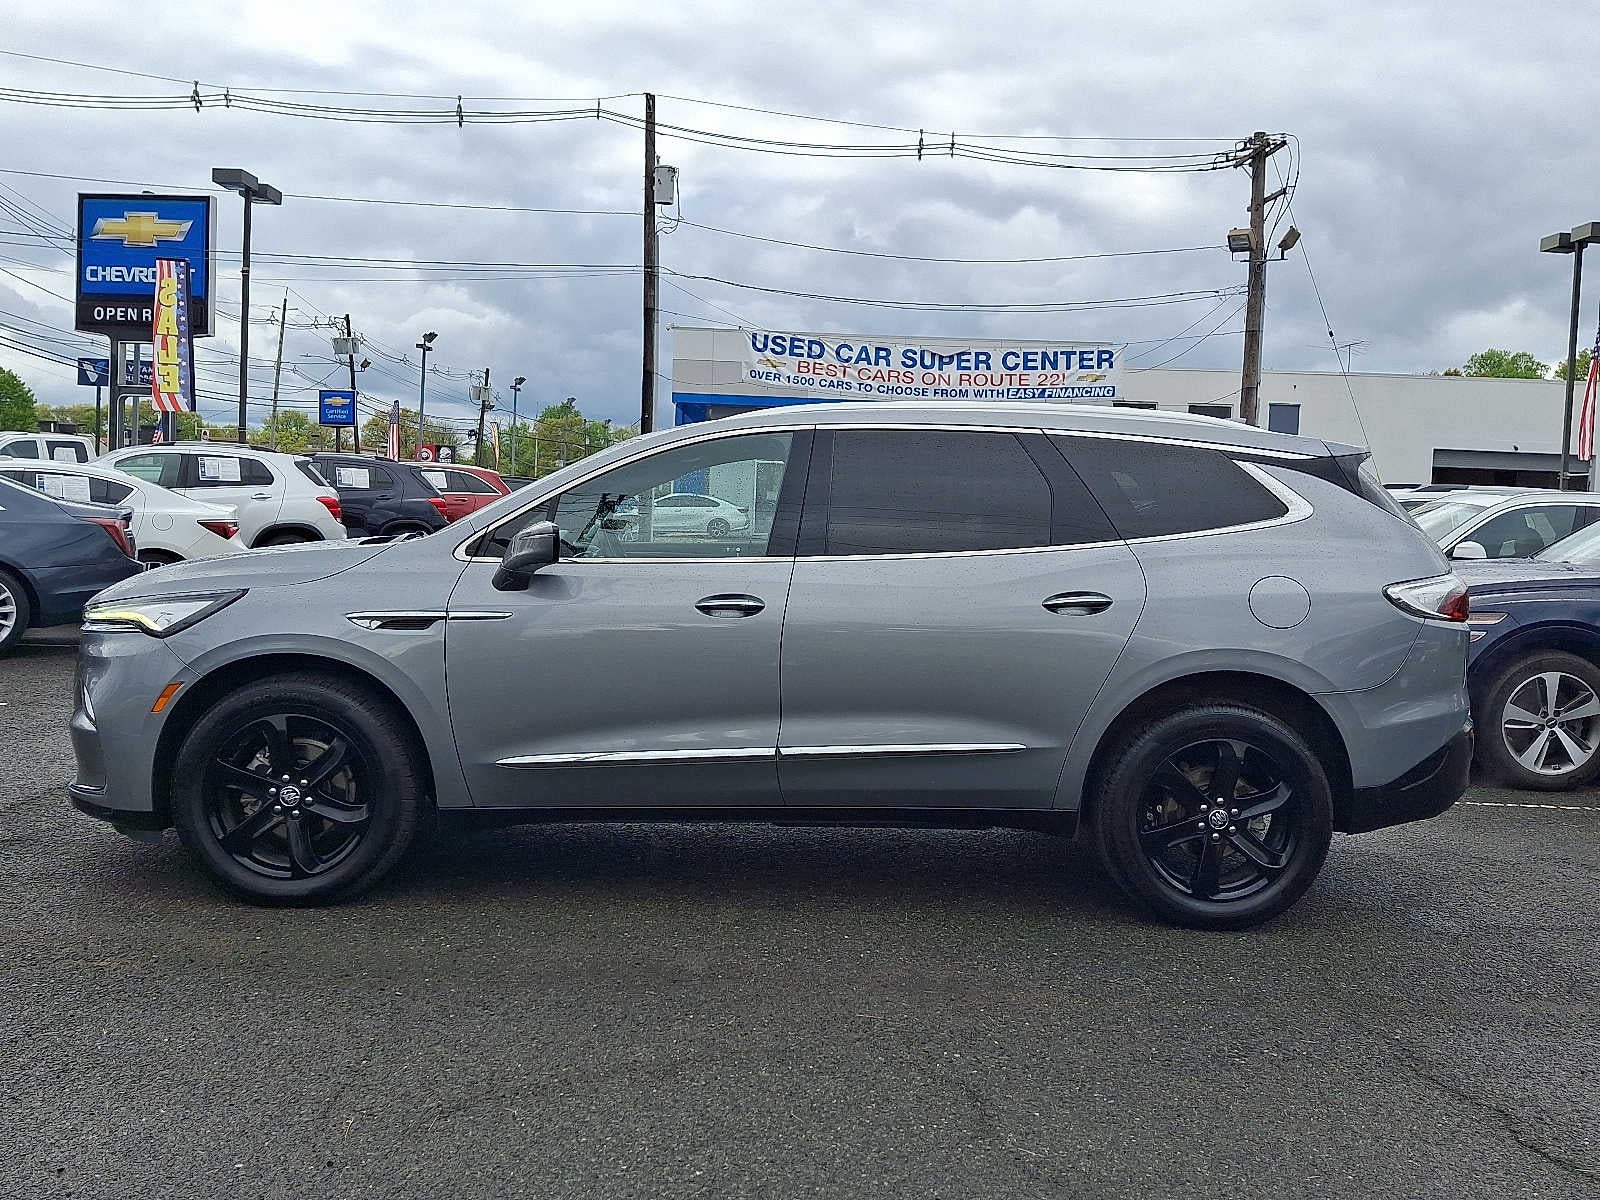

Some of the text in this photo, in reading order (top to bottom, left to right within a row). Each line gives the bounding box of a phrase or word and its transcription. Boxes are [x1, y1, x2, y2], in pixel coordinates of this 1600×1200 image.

[85, 265, 196, 283] CHEVRO
[93, 306, 138, 321] OPEN
[751, 332, 1114, 371] USED CAR SUPER CENTER
[749, 369, 1114, 399] OVER 1500 CARS TO CHOOSE FROM WITH EASY FINANCING
[797, 360, 1066, 387] BEST CARS ON ROUTE 22!
